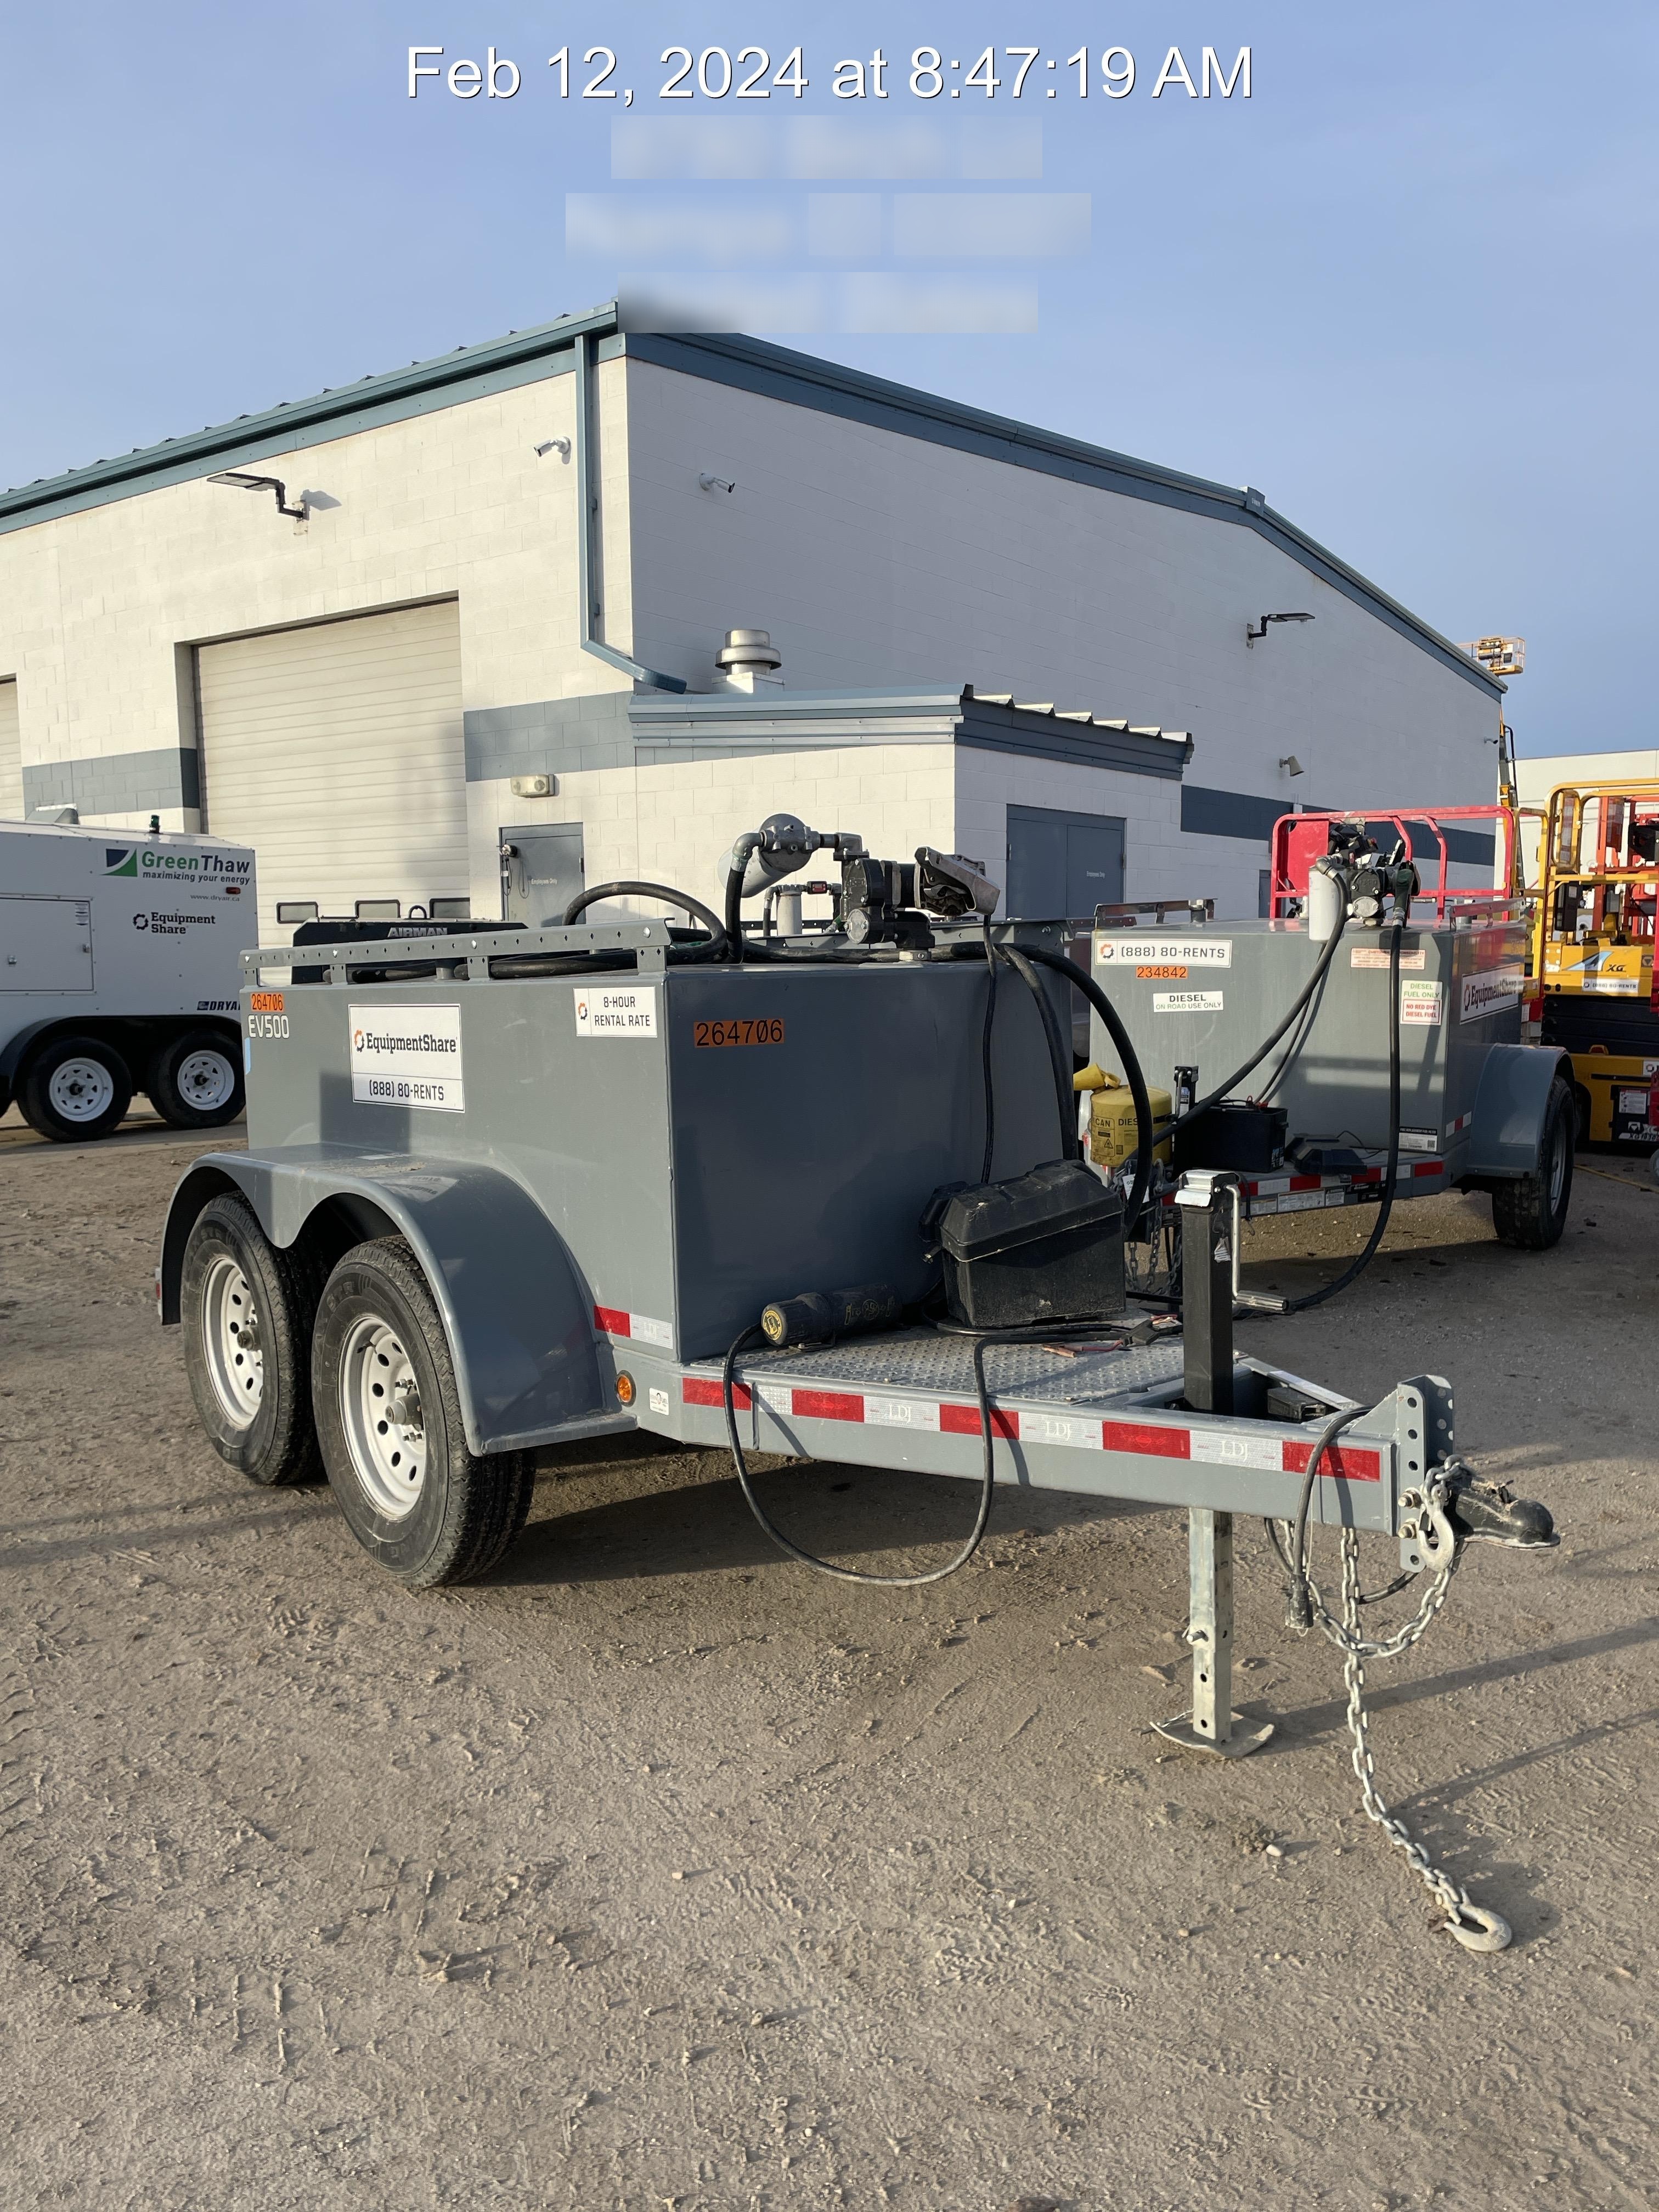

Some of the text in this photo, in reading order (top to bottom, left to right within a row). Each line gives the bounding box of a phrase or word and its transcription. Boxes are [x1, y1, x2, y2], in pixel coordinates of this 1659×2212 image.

[143, 871, 250, 885] maximizing your energy
[190, 894, 240, 902] www.dryair.ca
[151, 912, 216, 925] Equipment
[151, 924, 186, 934] Share
[387, 927, 448, 938] AIRMAN
[1121, 946, 1225, 958] (888) 80-RENTS
[1137, 967, 1187, 978] 234842
[251, 994, 284, 1011] 264706
[603, 996, 635, 1008] 8-HOUR
[248, 1015, 290, 1039] EV500
[594, 1014, 651, 1027] RENTAL RATE
[696, 1019, 783, 1046] 264706
[366, 1032, 456, 1054] EquipmentShare
[369, 1079, 444, 1101] (888) 80-RENTS
[1095, 1118, 1111, 1127] CAN
[1118, 1118, 1138, 1126] DIES
[1046, 1420, 1071, 1441] LDJ
[1220, 1441, 1249, 1462] LDJ
